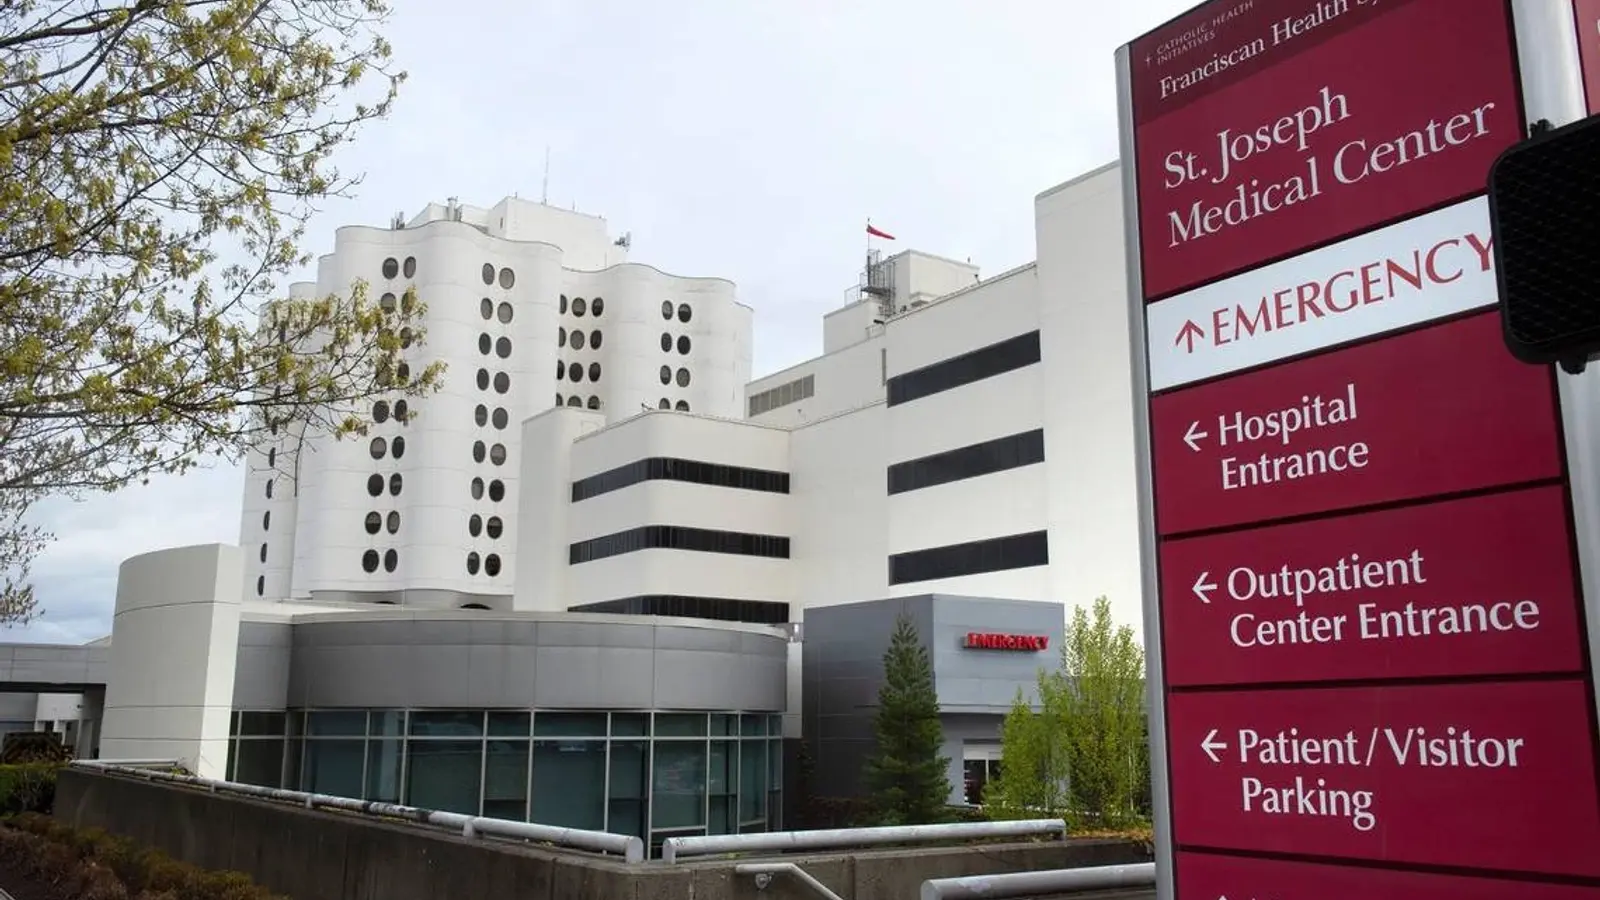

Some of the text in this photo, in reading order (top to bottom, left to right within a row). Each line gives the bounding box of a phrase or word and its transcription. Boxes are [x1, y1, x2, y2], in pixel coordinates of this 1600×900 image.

[1156, 0, 1253, 55] CATHOLIC HEALTH
[1157, 30, 1216, 65] INITIATIVES
[1159, 0, 1348, 99] Franciscan Health
[1164, 86, 1351, 189] St. Joseph
[1168, 102, 1495, 248] Medical Center
[1212, 233, 1494, 346] EMERGENCY
[1218, 383, 1357, 446] Hospital
[1221, 442, 1369, 490] Entrance
[1227, 549, 1427, 606] Outpatient
[966, 632, 1049, 650] EMERGENCY
[1230, 600, 1540, 647] Center Entrance
[1241, 776, 1376, 831] Parking
